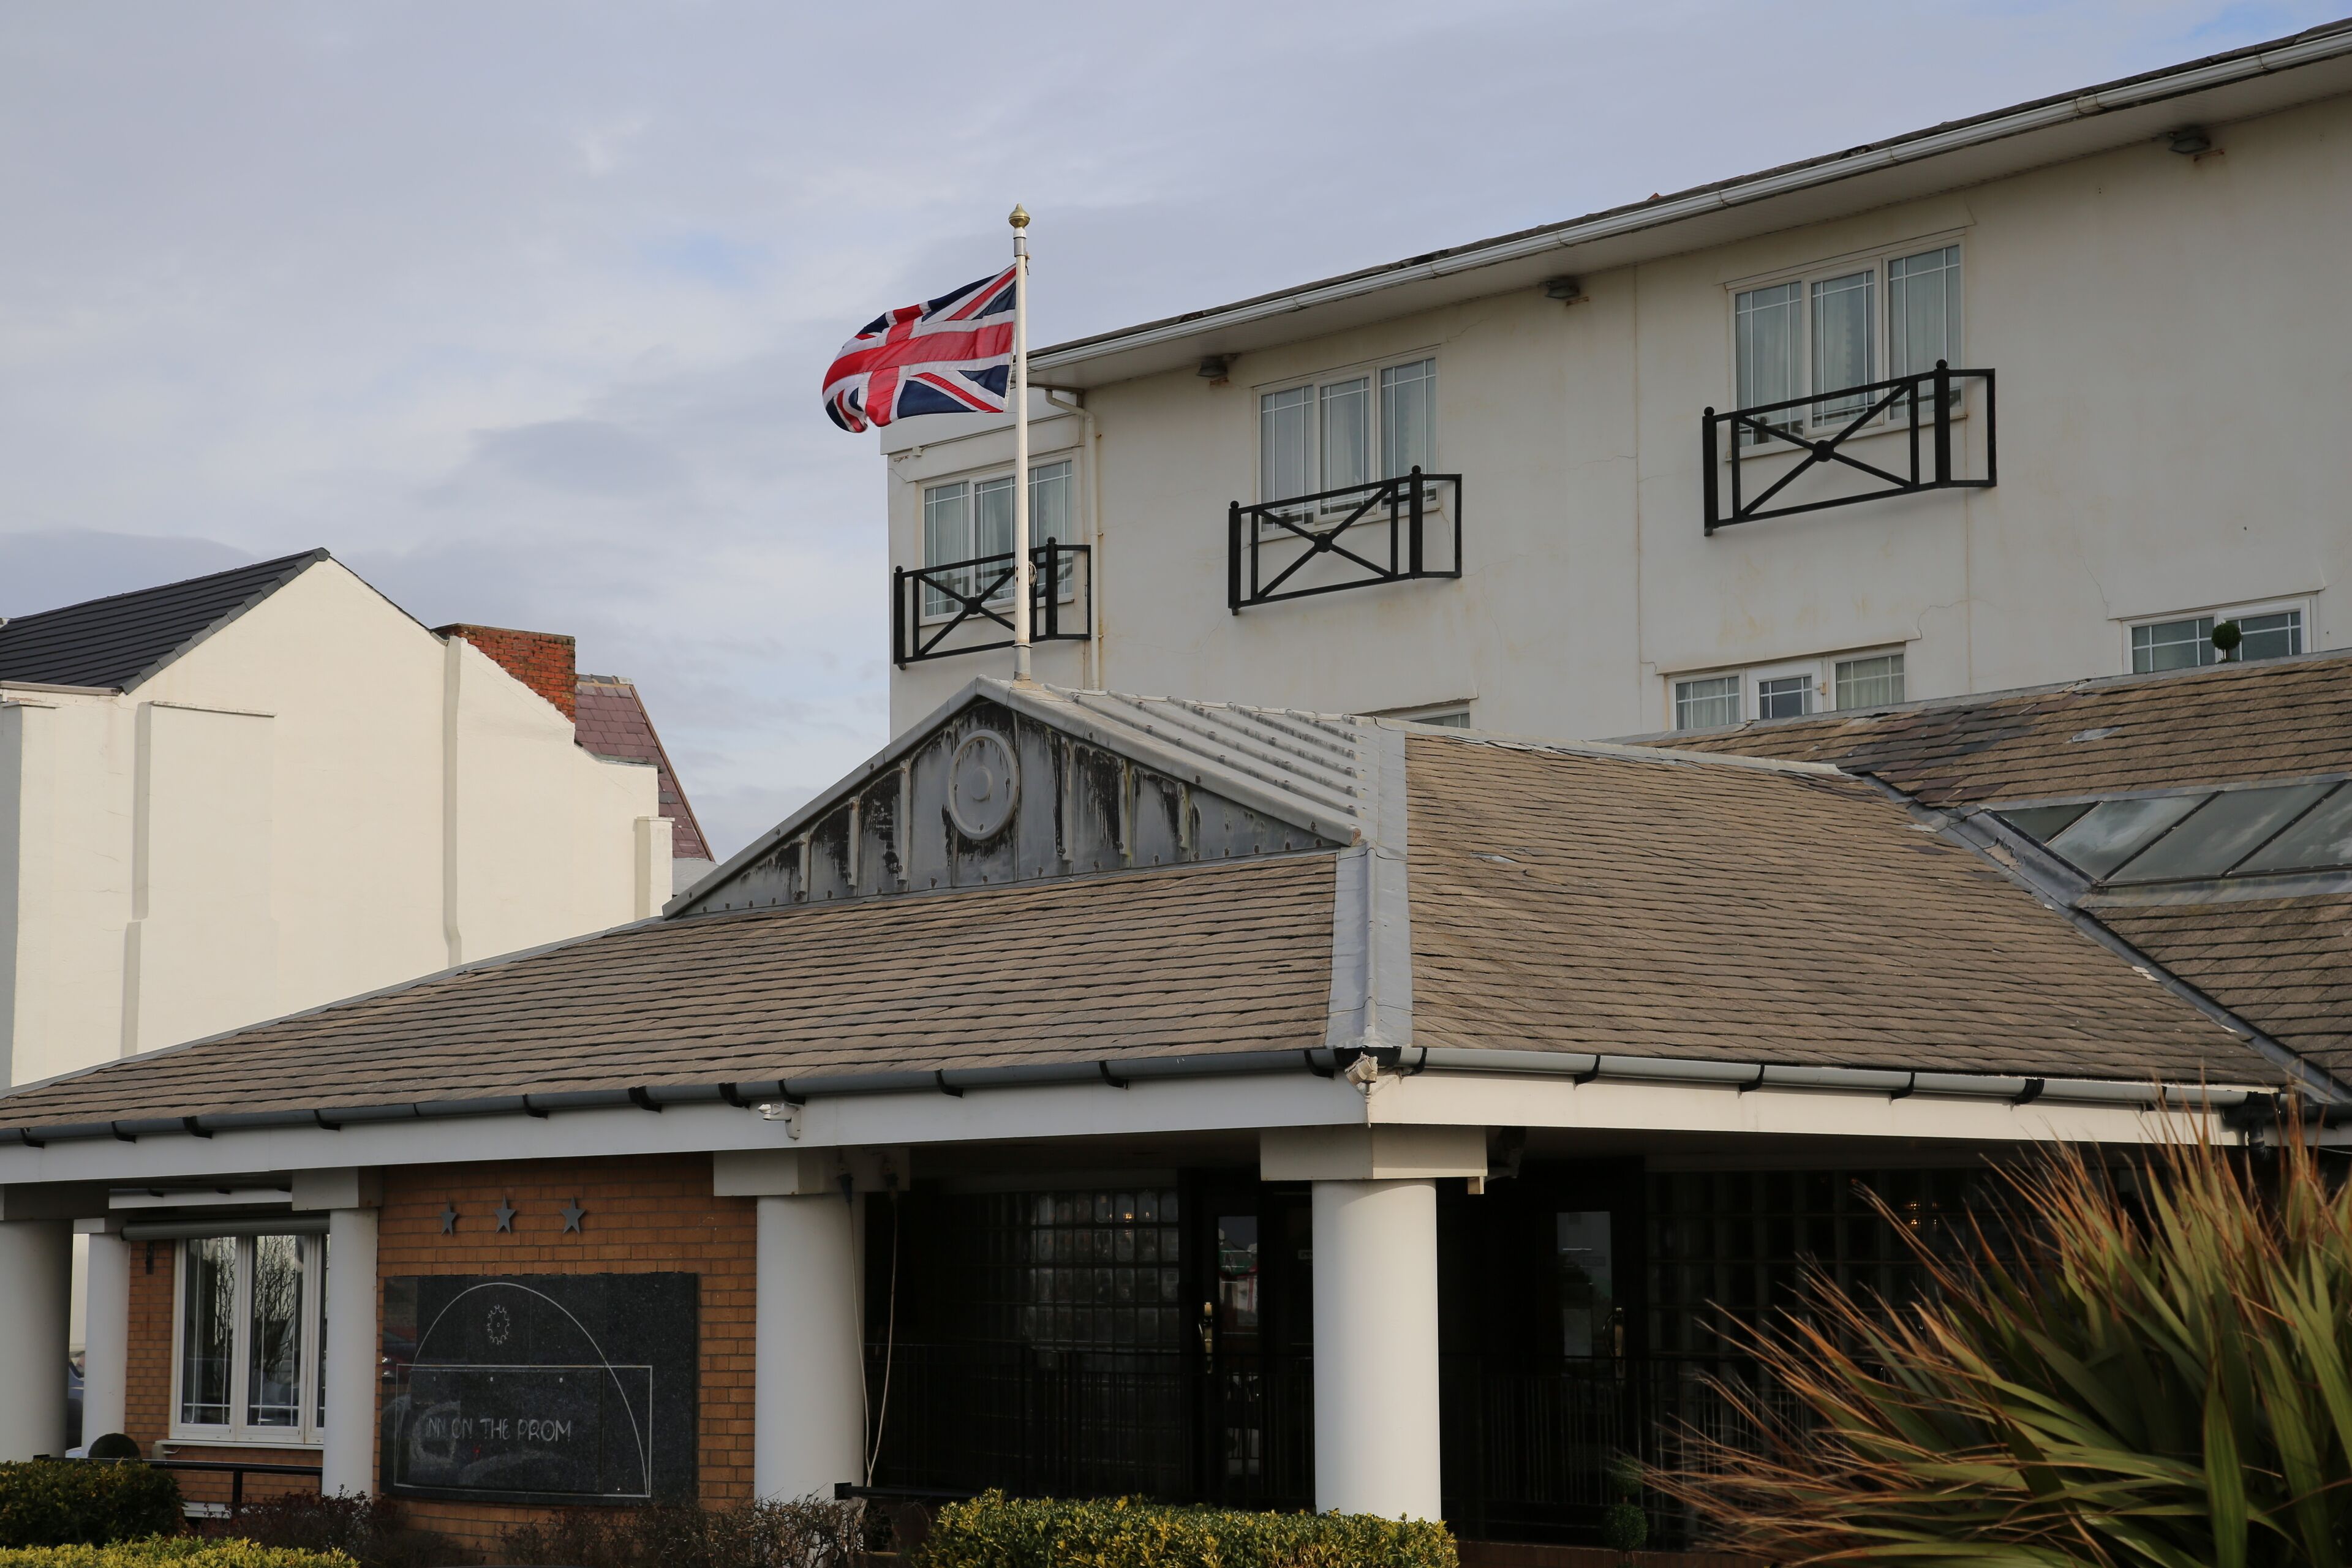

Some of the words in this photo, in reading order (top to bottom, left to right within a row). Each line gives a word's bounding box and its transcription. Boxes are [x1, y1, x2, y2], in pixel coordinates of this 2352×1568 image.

[451, 1418, 473, 1439] ON
[480, 1418, 510, 1440] THE
[518, 1419, 571, 1442] PROM
